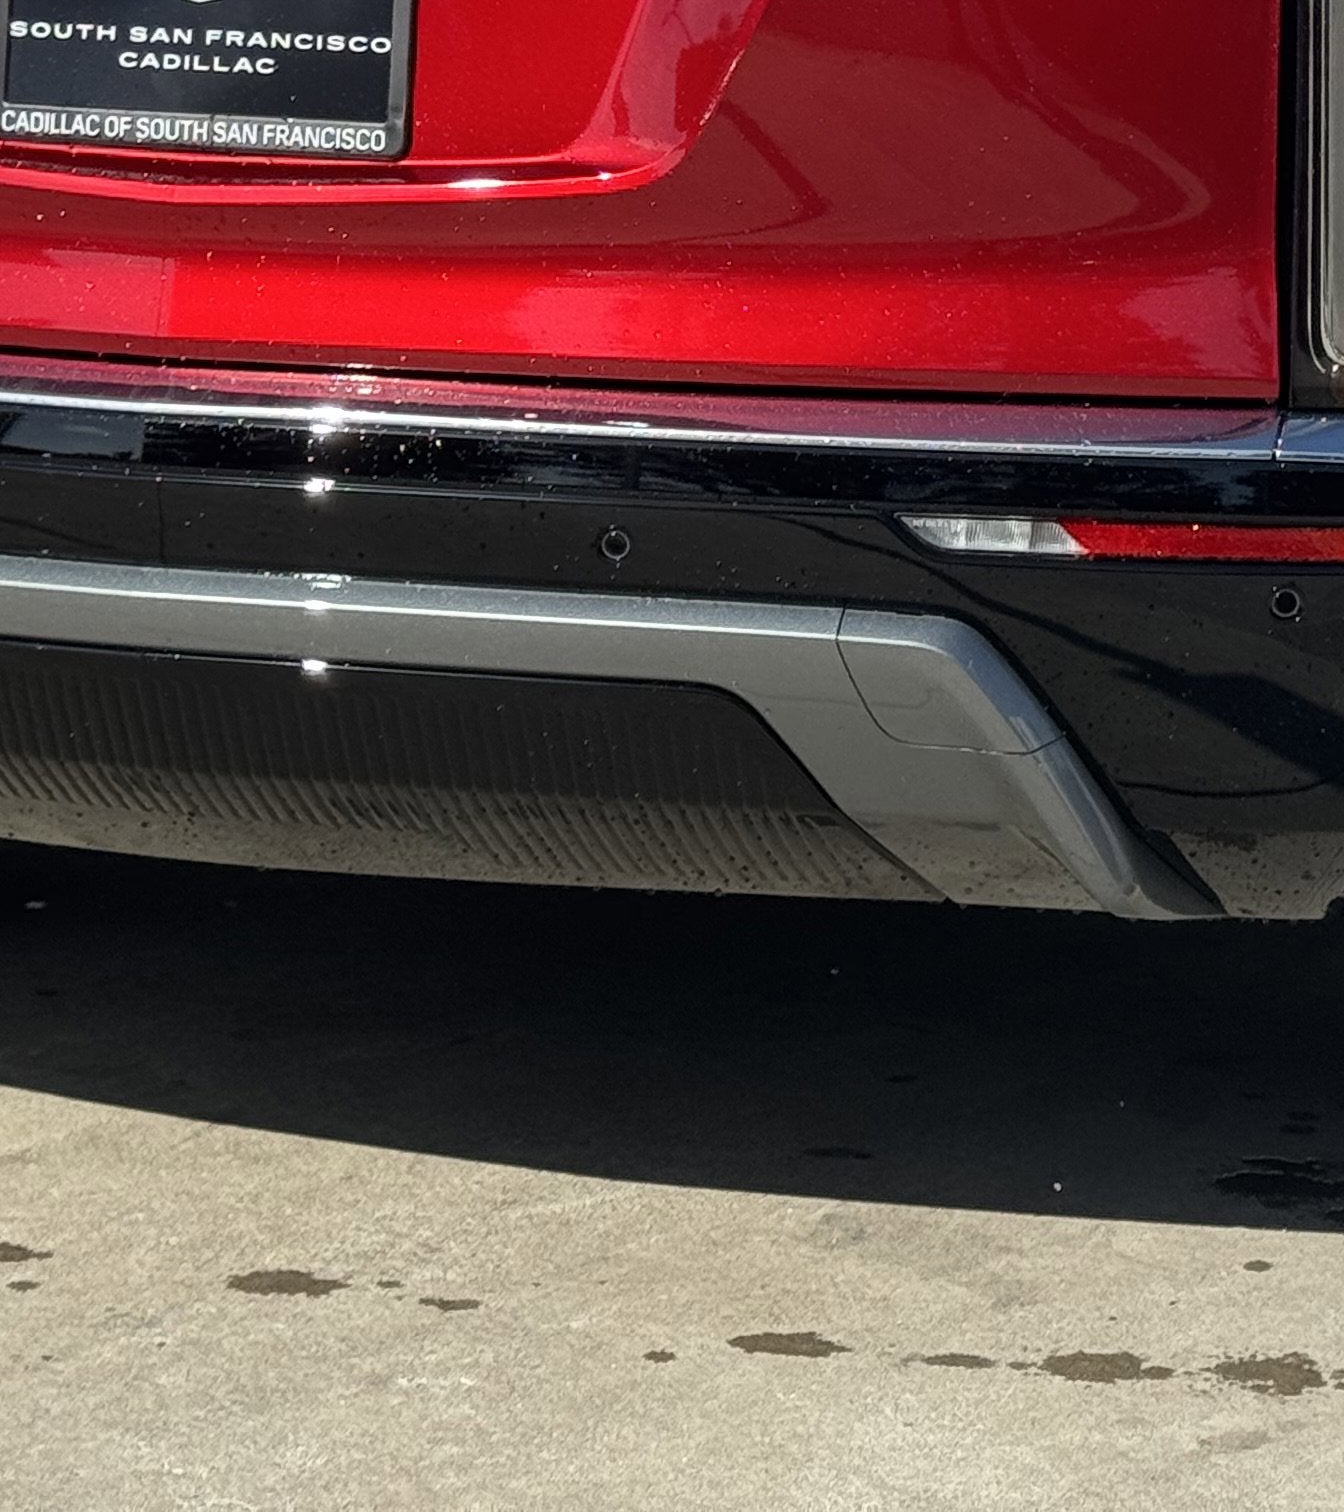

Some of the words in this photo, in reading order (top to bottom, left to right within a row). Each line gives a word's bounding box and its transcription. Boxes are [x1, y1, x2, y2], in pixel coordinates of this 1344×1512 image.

[9, 20, 117, 42] SOUTH
[129, 25, 193, 45] SAN
[205, 28, 392, 54] FRANCISCO
[118, 51, 276, 75] CADILLAC
[1, 109, 100, 136] CADILLAC
[104, 115, 132, 138] OF
[135, 117, 209, 143] SOUTH
[213, 121, 257, 145] SAN
[262, 124, 386, 152] FRANCISCO
